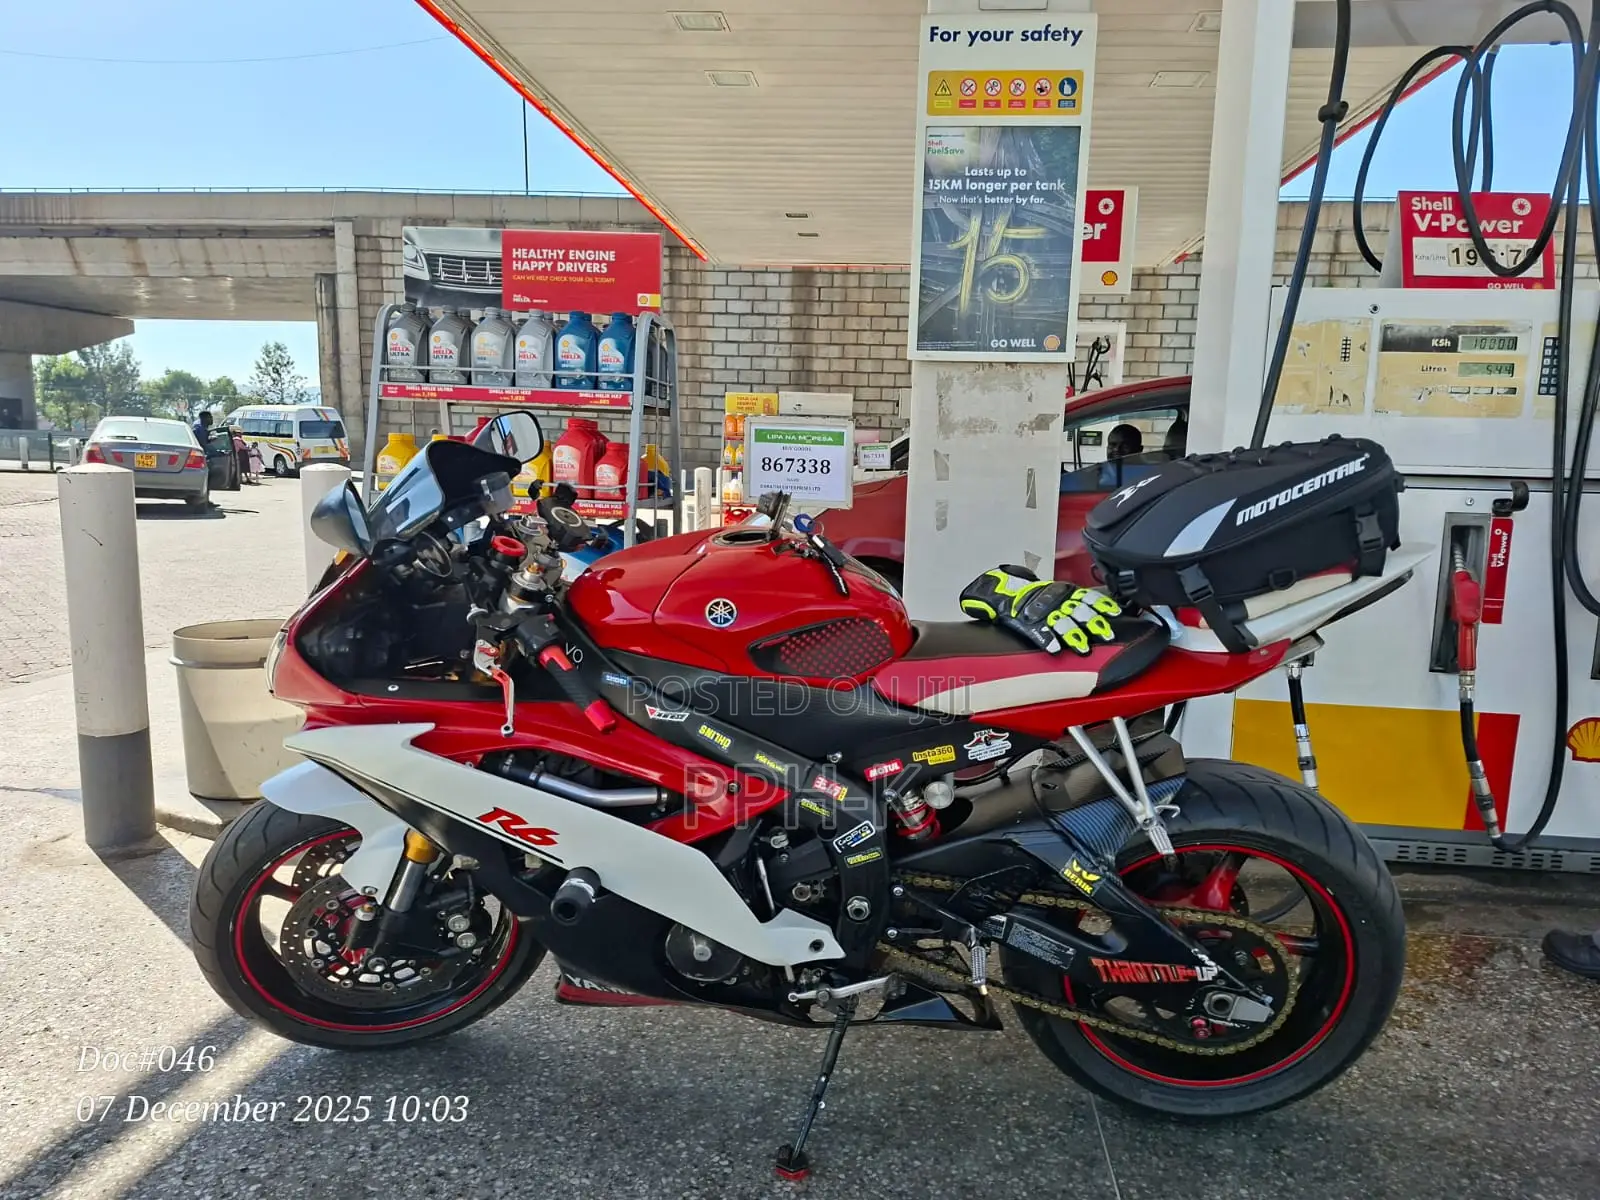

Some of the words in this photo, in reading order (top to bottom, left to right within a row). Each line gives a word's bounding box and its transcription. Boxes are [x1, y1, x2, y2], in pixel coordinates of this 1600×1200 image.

[929, 25, 960, 43] For
[967, 28, 1013, 47] your
[1020, 24, 1083, 46] safety
[927, 146, 965, 155] FuelSave
[964, 166, 994, 177] Lasts
[997, 169, 1012, 178] up
[1014, 168, 1027, 177] to
[928, 179, 963, 190] 15KM
[966, 179, 1006, 192] longer
[1010, 182, 1032, 193] per
[1035, 179, 1066, 190] tank
[939, 196, 958, 204] Now
[960, 196, 982, 204] that's
[984, 196, 1013, 204] better
[1016, 196, 1028, 206] by
[1412, 196, 1453, 211] Shell
[1412, 212, 1524, 234] V-Power
[512, 248, 566, 260] HEALTHY
[568, 250, 616, 262] ENGINE
[512, 261, 554, 272] HAPPY
[556, 262, 608, 273] DRIVERS
[1487, 282, 1502, 290] GO
[990, 339, 1008, 348] GO
[1010, 338, 1036, 348] WELL
[1431, 338, 1451, 348] KSh
[761, 456, 831, 474] 867338
[1236, 455, 1367, 527] MOTOCENTRIC
[1496, 532, 1508, 568] V-Power
[914, 746, 953, 761] Insta360
[870, 762, 900, 778] MOTUL
[476, 806, 560, 846] R6
[838, 825, 870, 846] GoPro
[1063, 867, 1094, 894] BERIK
[1195, 966, 1218, 982] UP
